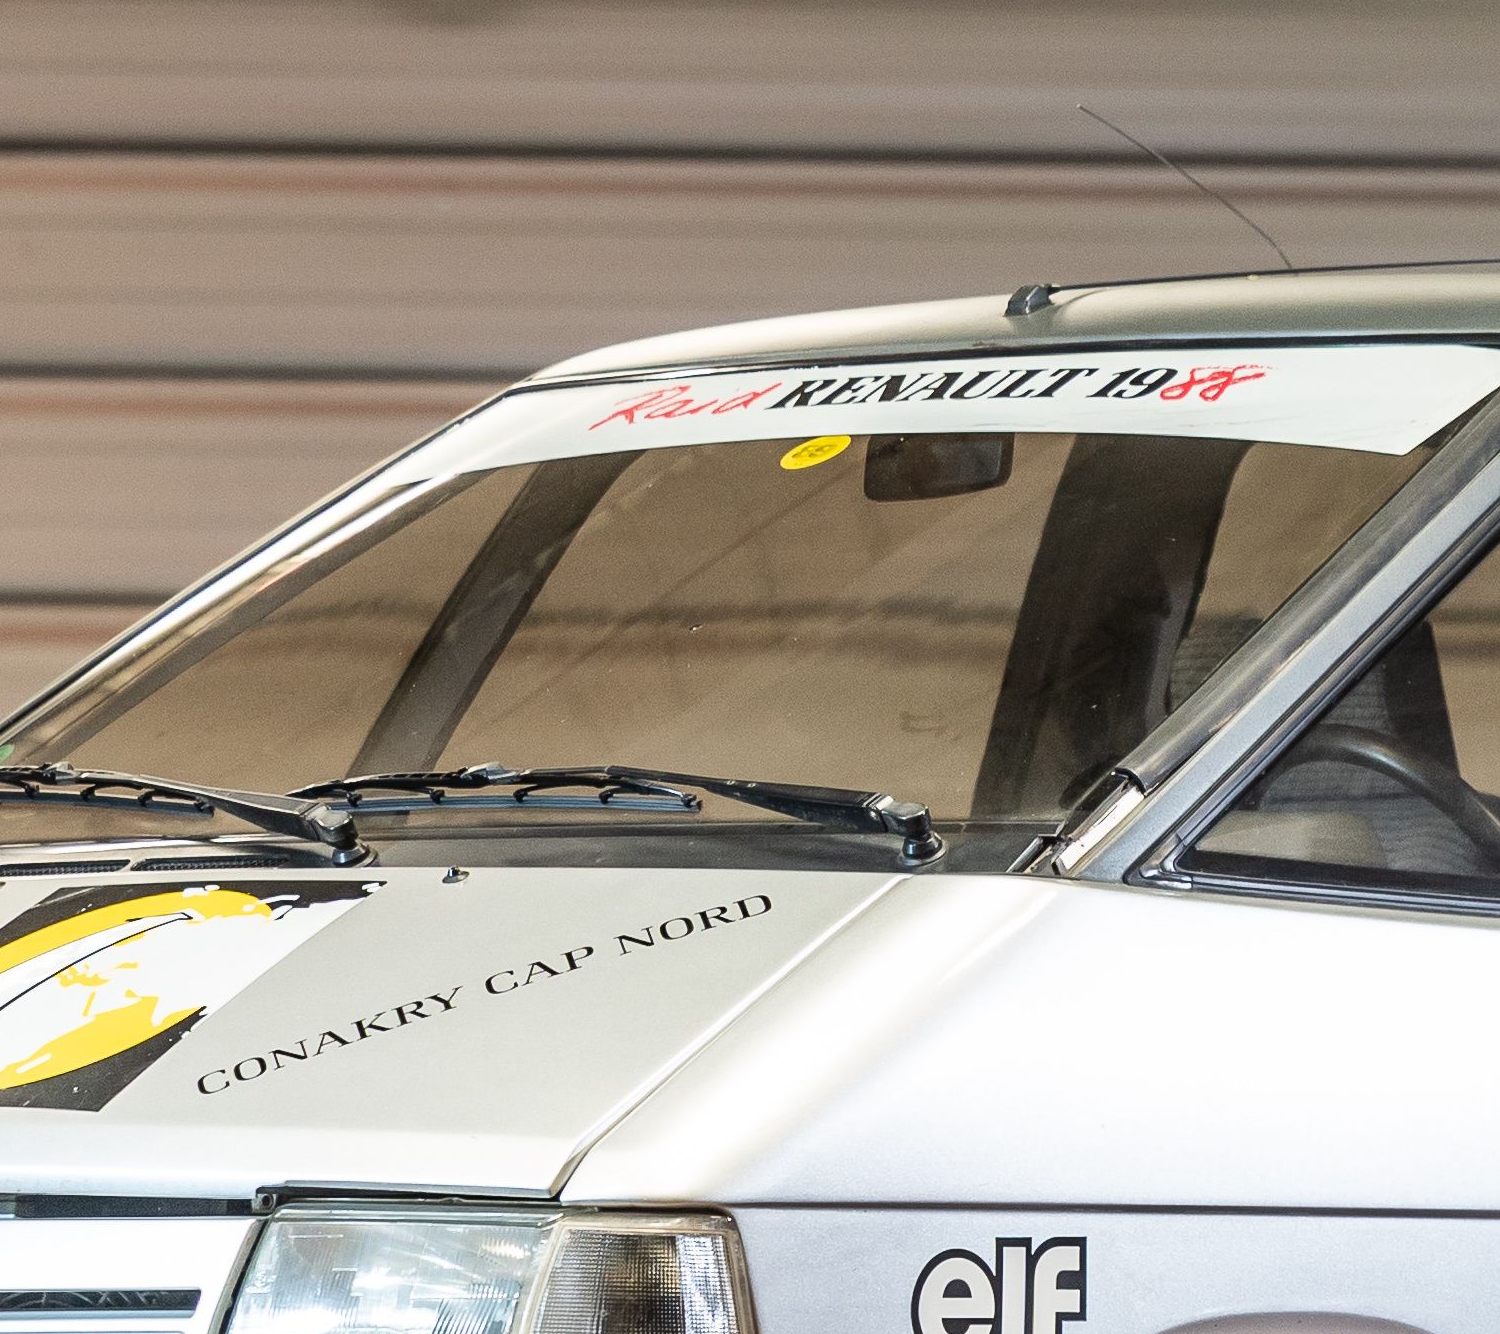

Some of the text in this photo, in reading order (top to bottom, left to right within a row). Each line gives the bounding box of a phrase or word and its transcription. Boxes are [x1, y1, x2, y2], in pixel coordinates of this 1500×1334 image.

[590, 379, 784, 431] Raid
[765, 367, 1097, 411] RENAULT
[196, 893, 773, 1098] CONAKRY CAP NORD
